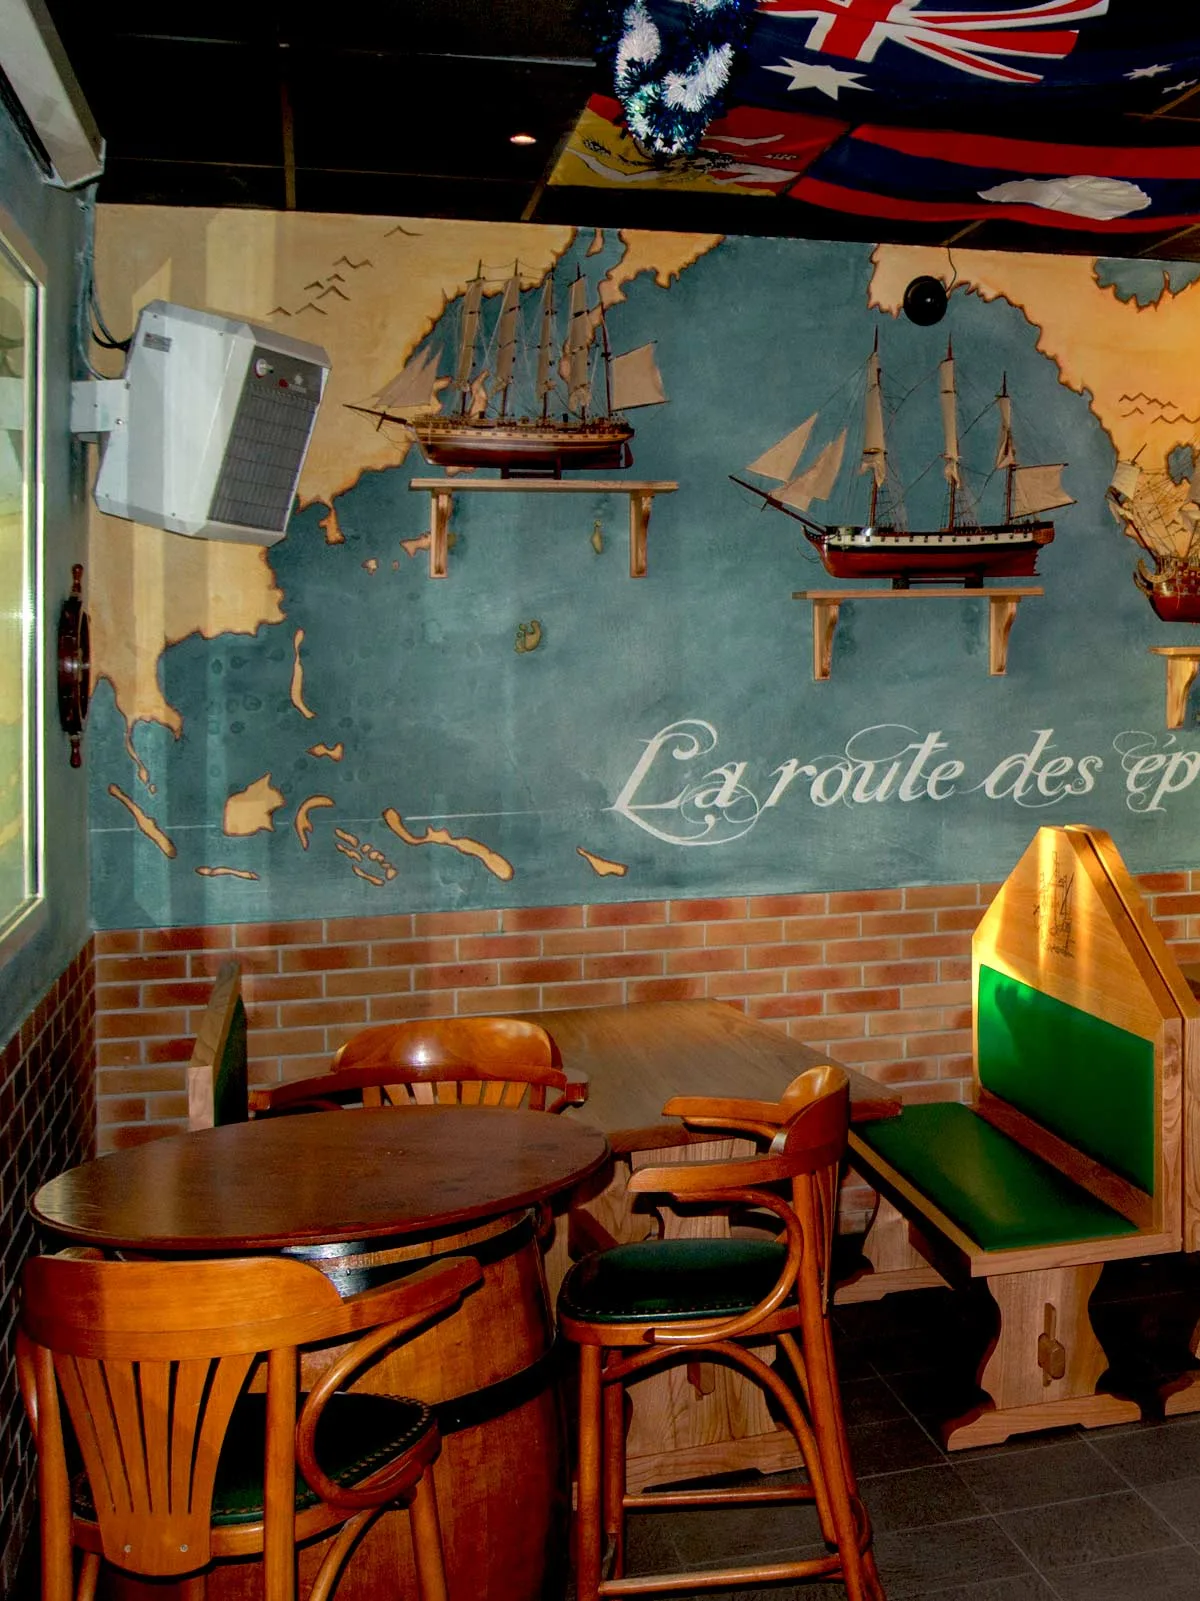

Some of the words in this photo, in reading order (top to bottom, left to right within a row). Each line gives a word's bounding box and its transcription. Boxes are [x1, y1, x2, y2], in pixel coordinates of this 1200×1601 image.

[612, 719, 757, 846] La
[765, 723, 965, 810] route
[980, 728, 1104, 809] des
